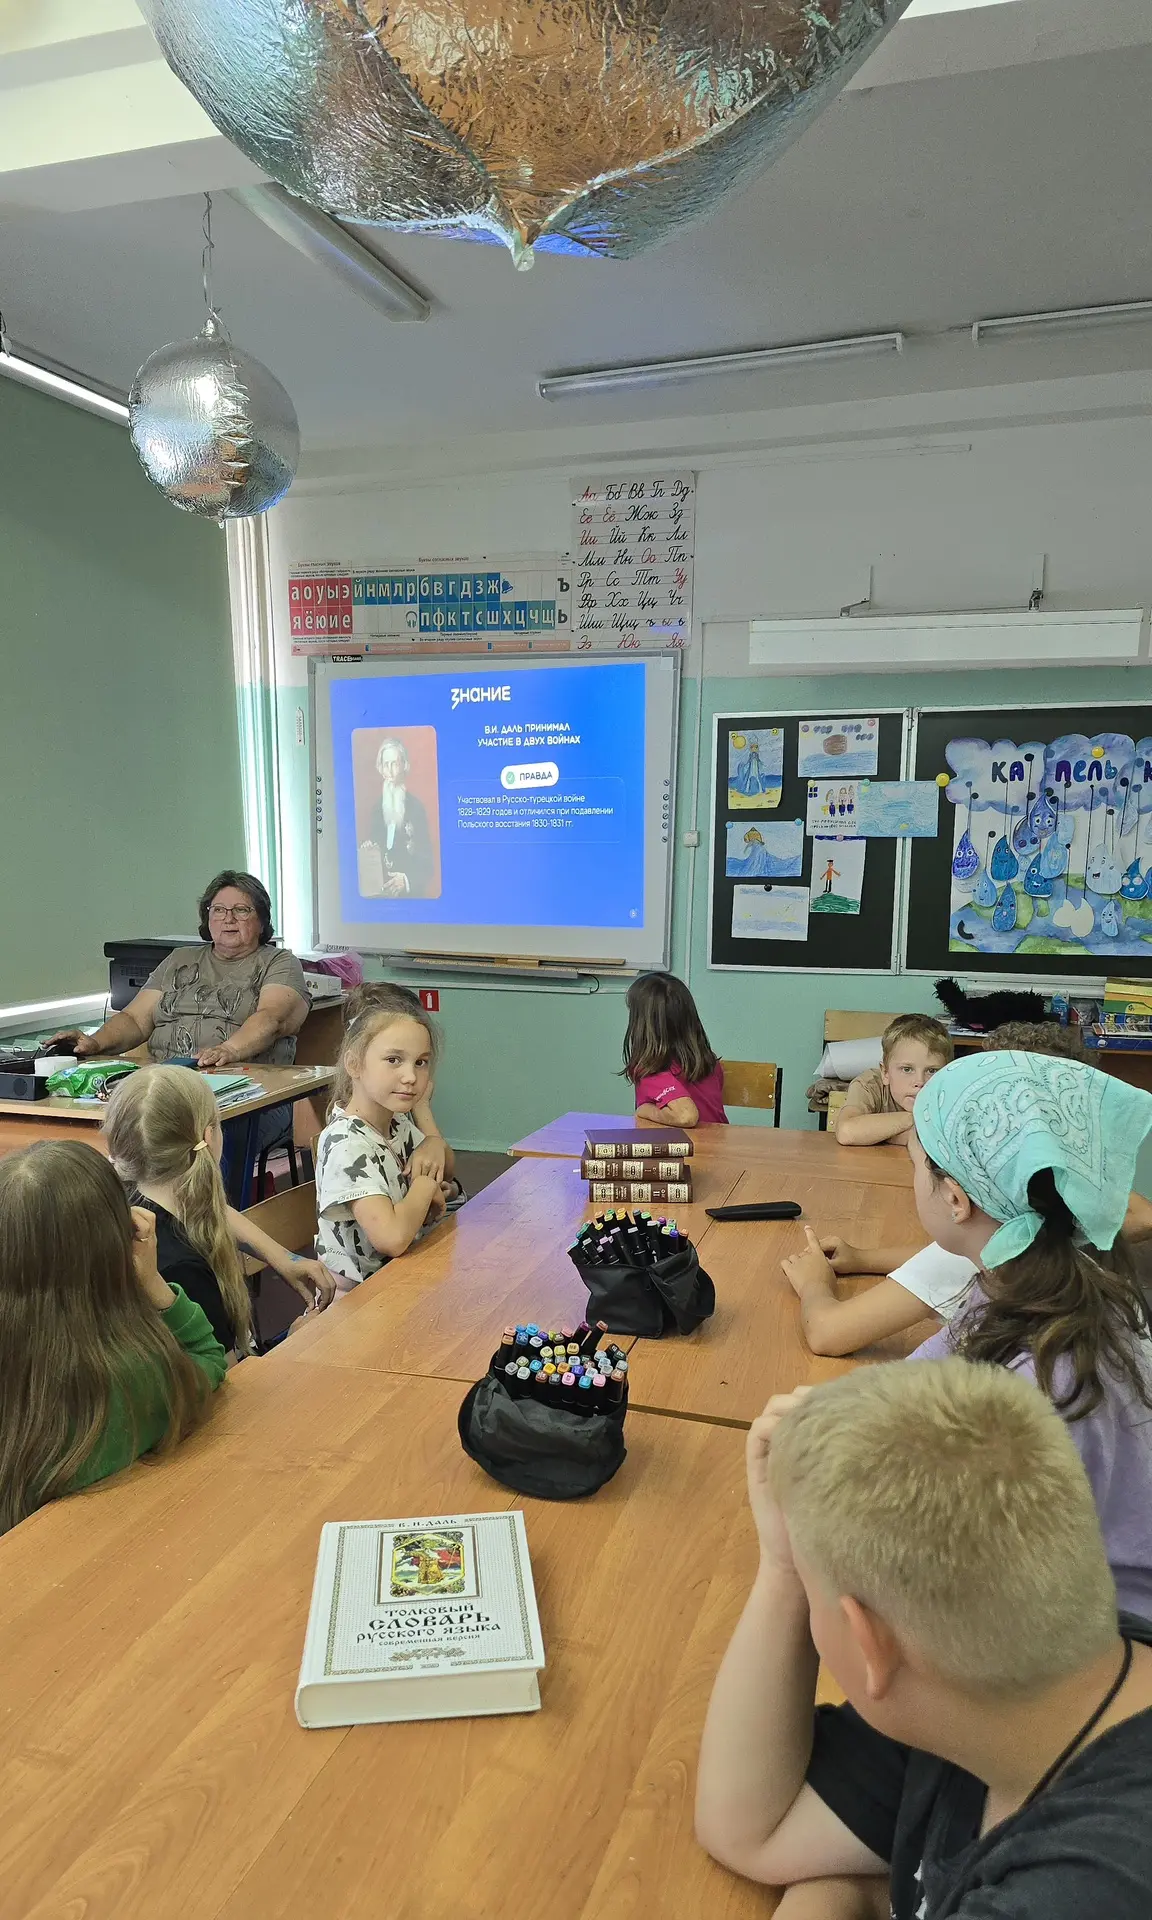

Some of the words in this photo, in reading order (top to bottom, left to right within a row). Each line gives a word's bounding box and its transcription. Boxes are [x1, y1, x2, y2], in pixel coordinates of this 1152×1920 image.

[606, 483, 627, 500] Бб
[628, 483, 644, 499] Вв
[671, 480, 690, 502] Дд
[602, 504, 616, 522] Ёё
[625, 504, 659, 521] Жж
[669, 502, 684, 525] Зз
[580, 529, 598, 546] Ии
[609, 525, 628, 544] Йй
[638, 525, 656, 543] Кк
[666, 524, 688, 541] Лл
[578, 550, 606, 566] Мм
[613, 548, 634, 565] Нн
[641, 547, 657, 564] Оо
[664, 545, 688, 562] Пп
[577, 571, 594, 594] Рр
[606, 570, 620, 586] Сс
[631, 569, 661, 585] Тт
[672, 567, 687, 589] Уу
[578, 593, 597, 613] Фф
[605, 591, 629, 608] Хх
[637, 590, 659, 610] Цц
[668, 589, 684, 605] Чч
[579, 613, 604, 629] Шш
[611, 613, 640, 632] Щщ
[577, 635, 592, 649] Ээ
[617, 633, 641, 649] Юю
[666, 632, 685, 648] Яя
[451, 685, 511, 710] ЗНАНИЕ
[501, 724, 523, 735] ДАЛЬ
[525, 722, 570, 733] ПРИНИМАЛ
[477, 737, 514, 748] УЧАСТИЕ
[515, 737, 522, 746] В
[524, 736, 545, 747] ДВУХ
[547, 733, 581, 745] ВОЙНАХ
[519, 771, 553, 781] ПРАВДА
[457, 795, 496, 804] Участвовал
[502, 793, 562, 806] Русско-турецкой
[563, 793, 586, 803] войне
[492, 808, 512, 816] годов
[556, 808, 570, 816] при
[571, 807, 614, 816] подавлении
[457, 819, 494, 828] Польского
[495, 820, 530, 828] восстания
[385, 1603, 474, 1617] ТОЛКОВЫЙ
[369, 1612, 490, 1631] СЛОВАРЬ
